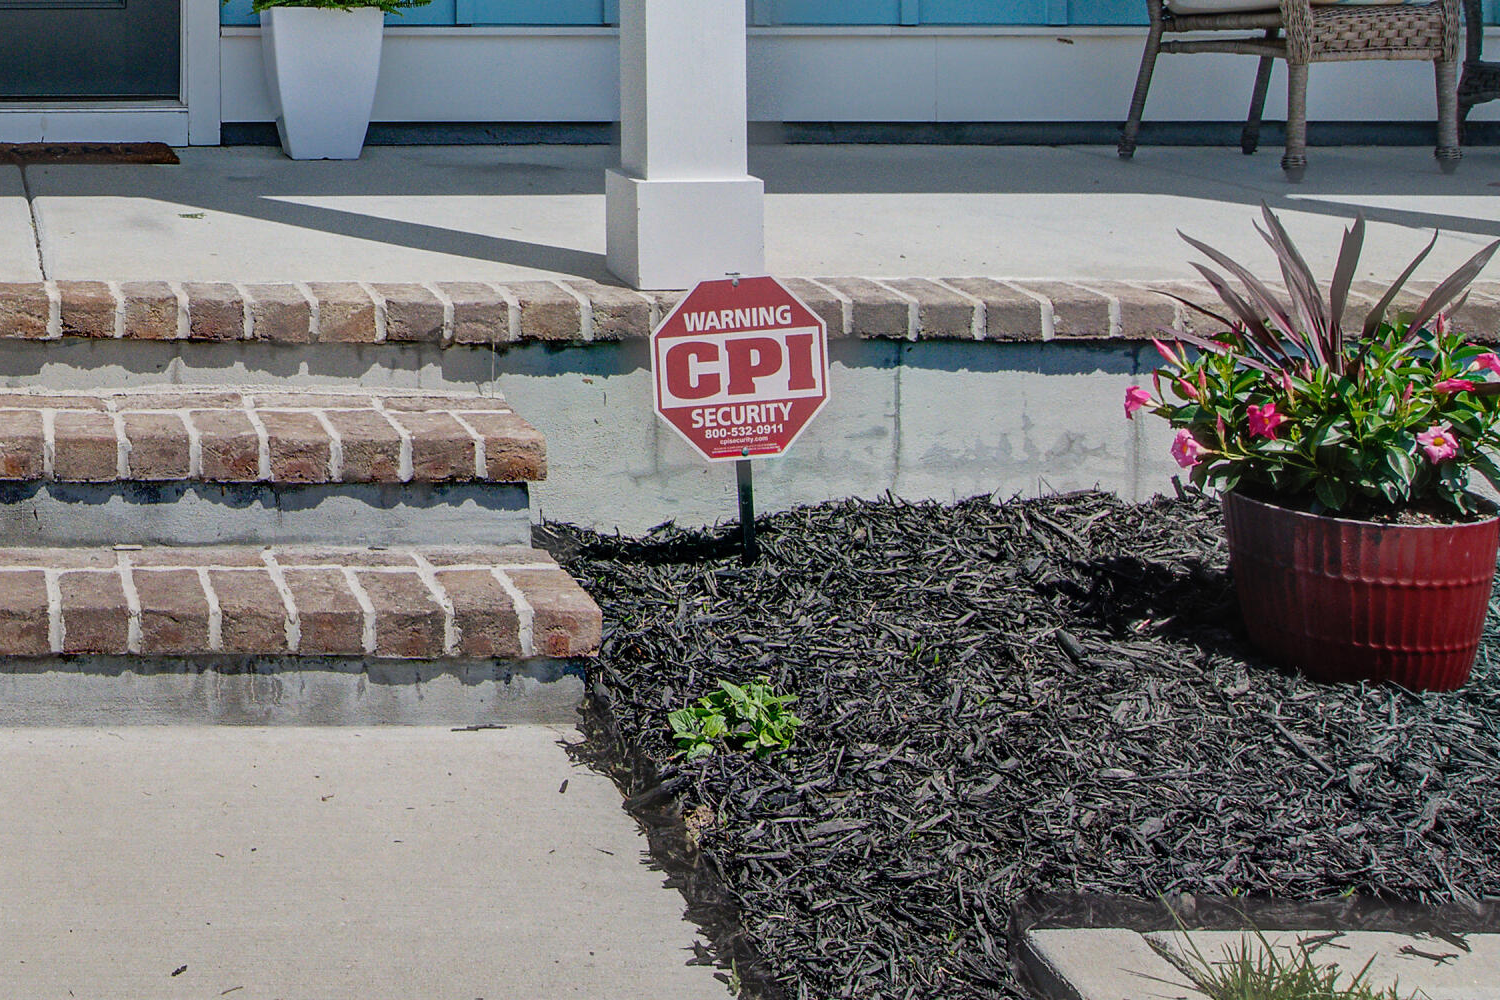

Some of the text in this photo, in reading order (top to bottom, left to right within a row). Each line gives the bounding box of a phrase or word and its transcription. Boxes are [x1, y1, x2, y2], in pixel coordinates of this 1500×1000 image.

[683, 305, 792, 332] WARNING
[666, 333, 817, 400] CPI
[691, 402, 793, 429] SECURITY
[705, 423, 784, 439] 800-532-0911
